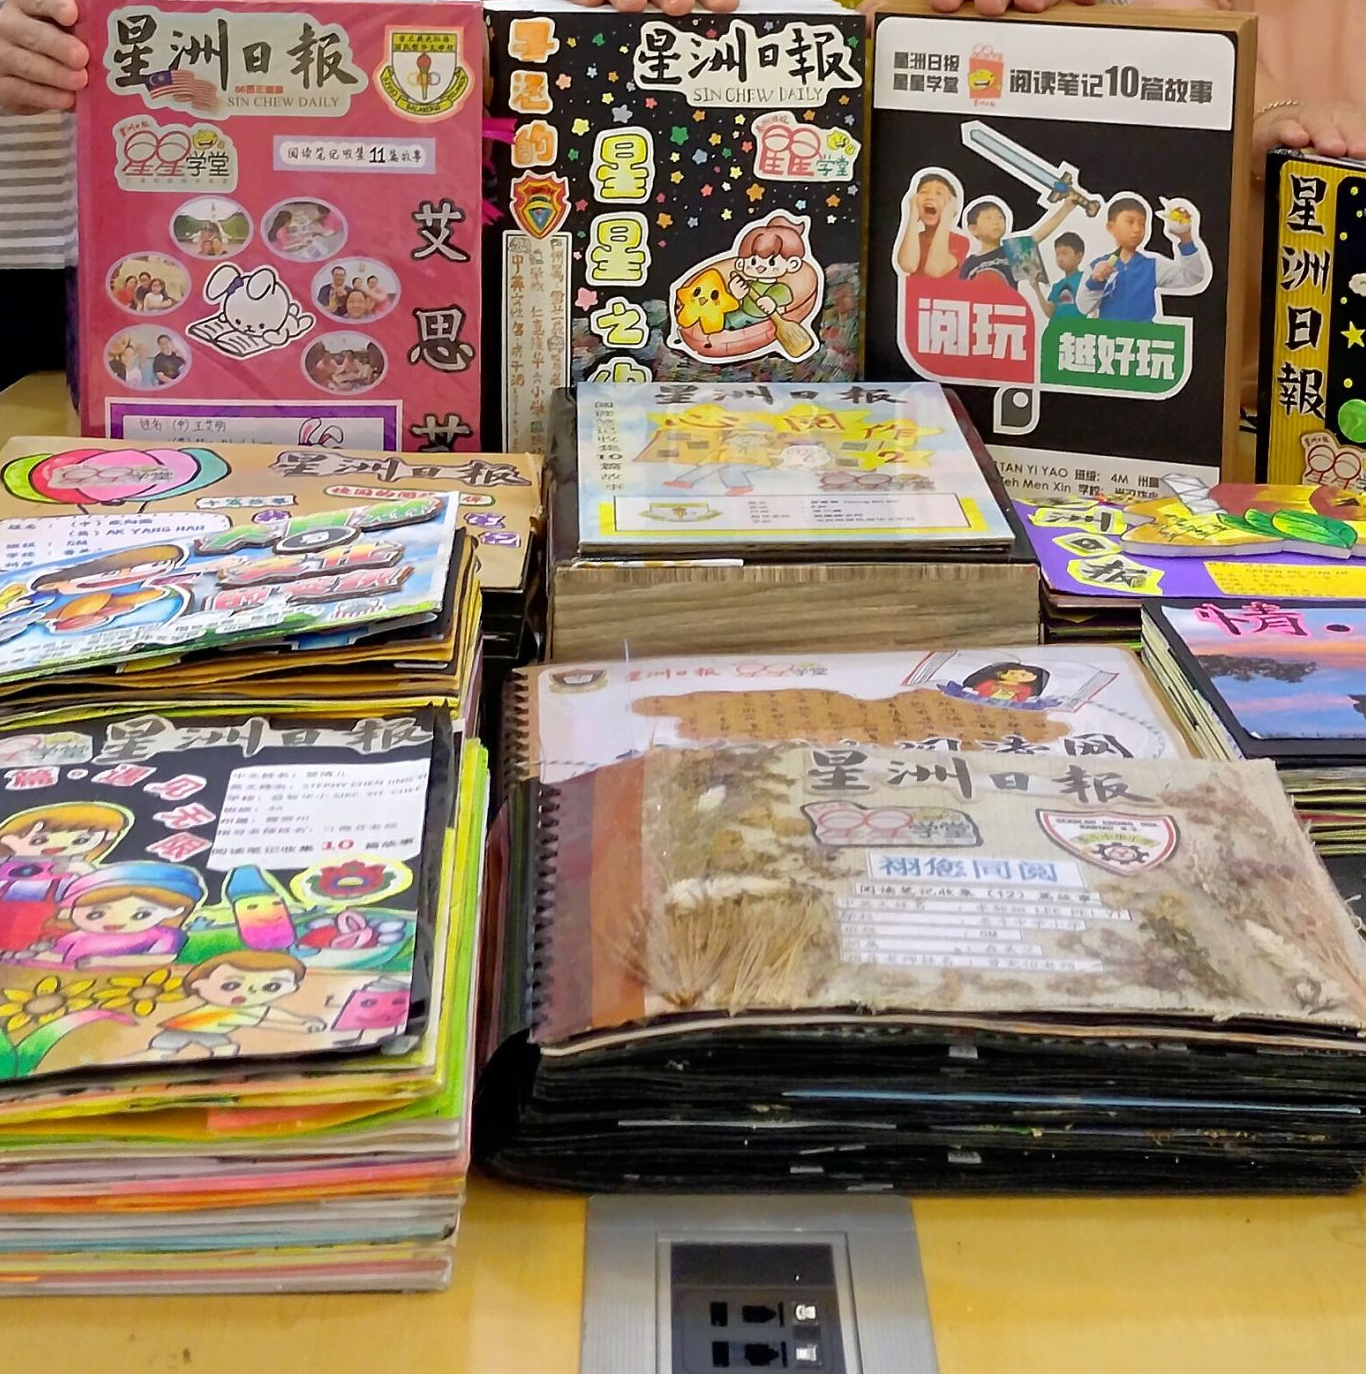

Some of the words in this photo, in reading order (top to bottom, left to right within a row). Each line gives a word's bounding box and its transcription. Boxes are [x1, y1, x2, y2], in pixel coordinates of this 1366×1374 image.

[894, 52, 959, 72] 星洲日报
[894, 72, 959, 93] 星星学堂
[1009, 65, 1213, 104] 阅读笔记10篇故事
[228, 96, 250, 107] SIN
[254, 96, 293, 107] CHEW
[298, 96, 339, 107] DAILY
[693, 87, 725, 103] SIN
[778, 85, 825, 102] DAILY
[1276, 173, 1332, 420] 星洲日報
[917, 298, 1027, 361] 阅玩
[1058, 332, 1176, 380] 越好玩
[1000, 461, 1023, 474] TAN
[1027, 464, 1038, 476] YI
[1041, 466, 1069, 478] YAO
[1111, 474, 1129, 485] 4M
[1023, 479, 1050, 491] Men
[1053, 482, 1071, 493] Xin
[808, 750, 1158, 803] 星洲日報
[321, 838, 355, 851] 10
